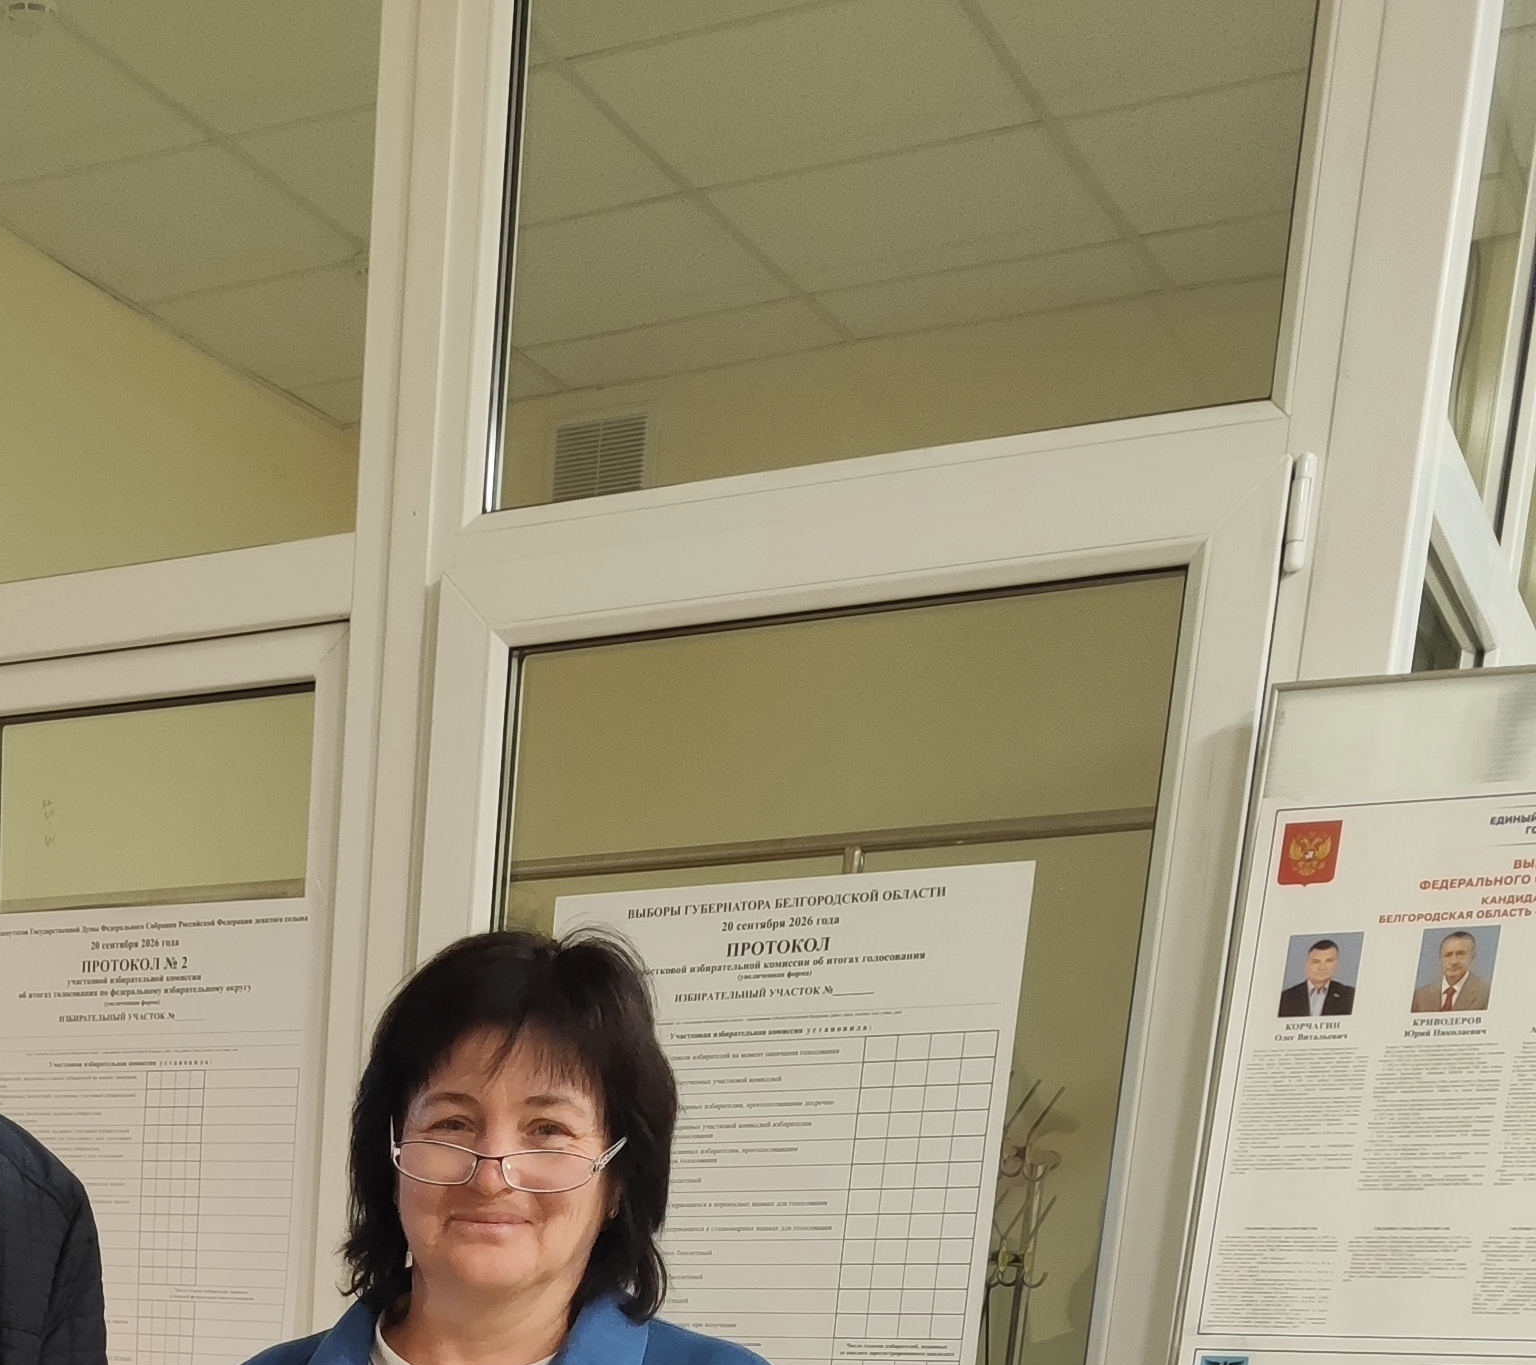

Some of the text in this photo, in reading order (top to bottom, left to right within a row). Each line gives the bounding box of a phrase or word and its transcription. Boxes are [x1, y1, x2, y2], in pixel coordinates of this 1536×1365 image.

[1419, 874, 1531, 890] ФЕДЕРАЛЬНОГО
[628, 886, 947, 920] ВЫБОРЫ ГУБЕРНАТОРА БЕЛГОРОДСКОЙ ОБЛАСТИ
[721, 915, 840, 932] 20 сентября 2026 года
[1378, 907, 1532, 924] БЕЛГОРОДСКАЯ ОБЛАСТЬ
[91, 938, 180, 950] 20 сентября 2026 года
[726, 936, 831, 958] ПРОТОКОЛ
[81, 956, 188, 973] ПРОТОКОЛ № 2
[689, 960, 761, 974] избирательной
[763, 959, 810, 969] комиссии
[813, 956, 824, 966] об
[826, 957, 859, 966] итогах
[862, 952, 926, 963] голосования
[674, 987, 766, 1003] ИЗБИРАТЕЛЬНЫЙ
[769, 986, 821, 998] УЧАСТОК
[59, 1012, 126, 1023] ИЗБИРАТЕЛЬНЫЙ
[128, 1012, 166, 1021] УЧАСТОК
[1285, 1021, 1341, 1031] КОРЧАГИН
[1412, 1016, 1482, 1027] КРИВОДЕРОВ
[1404, 1028, 1487, 1039] Юрий Николаевич
